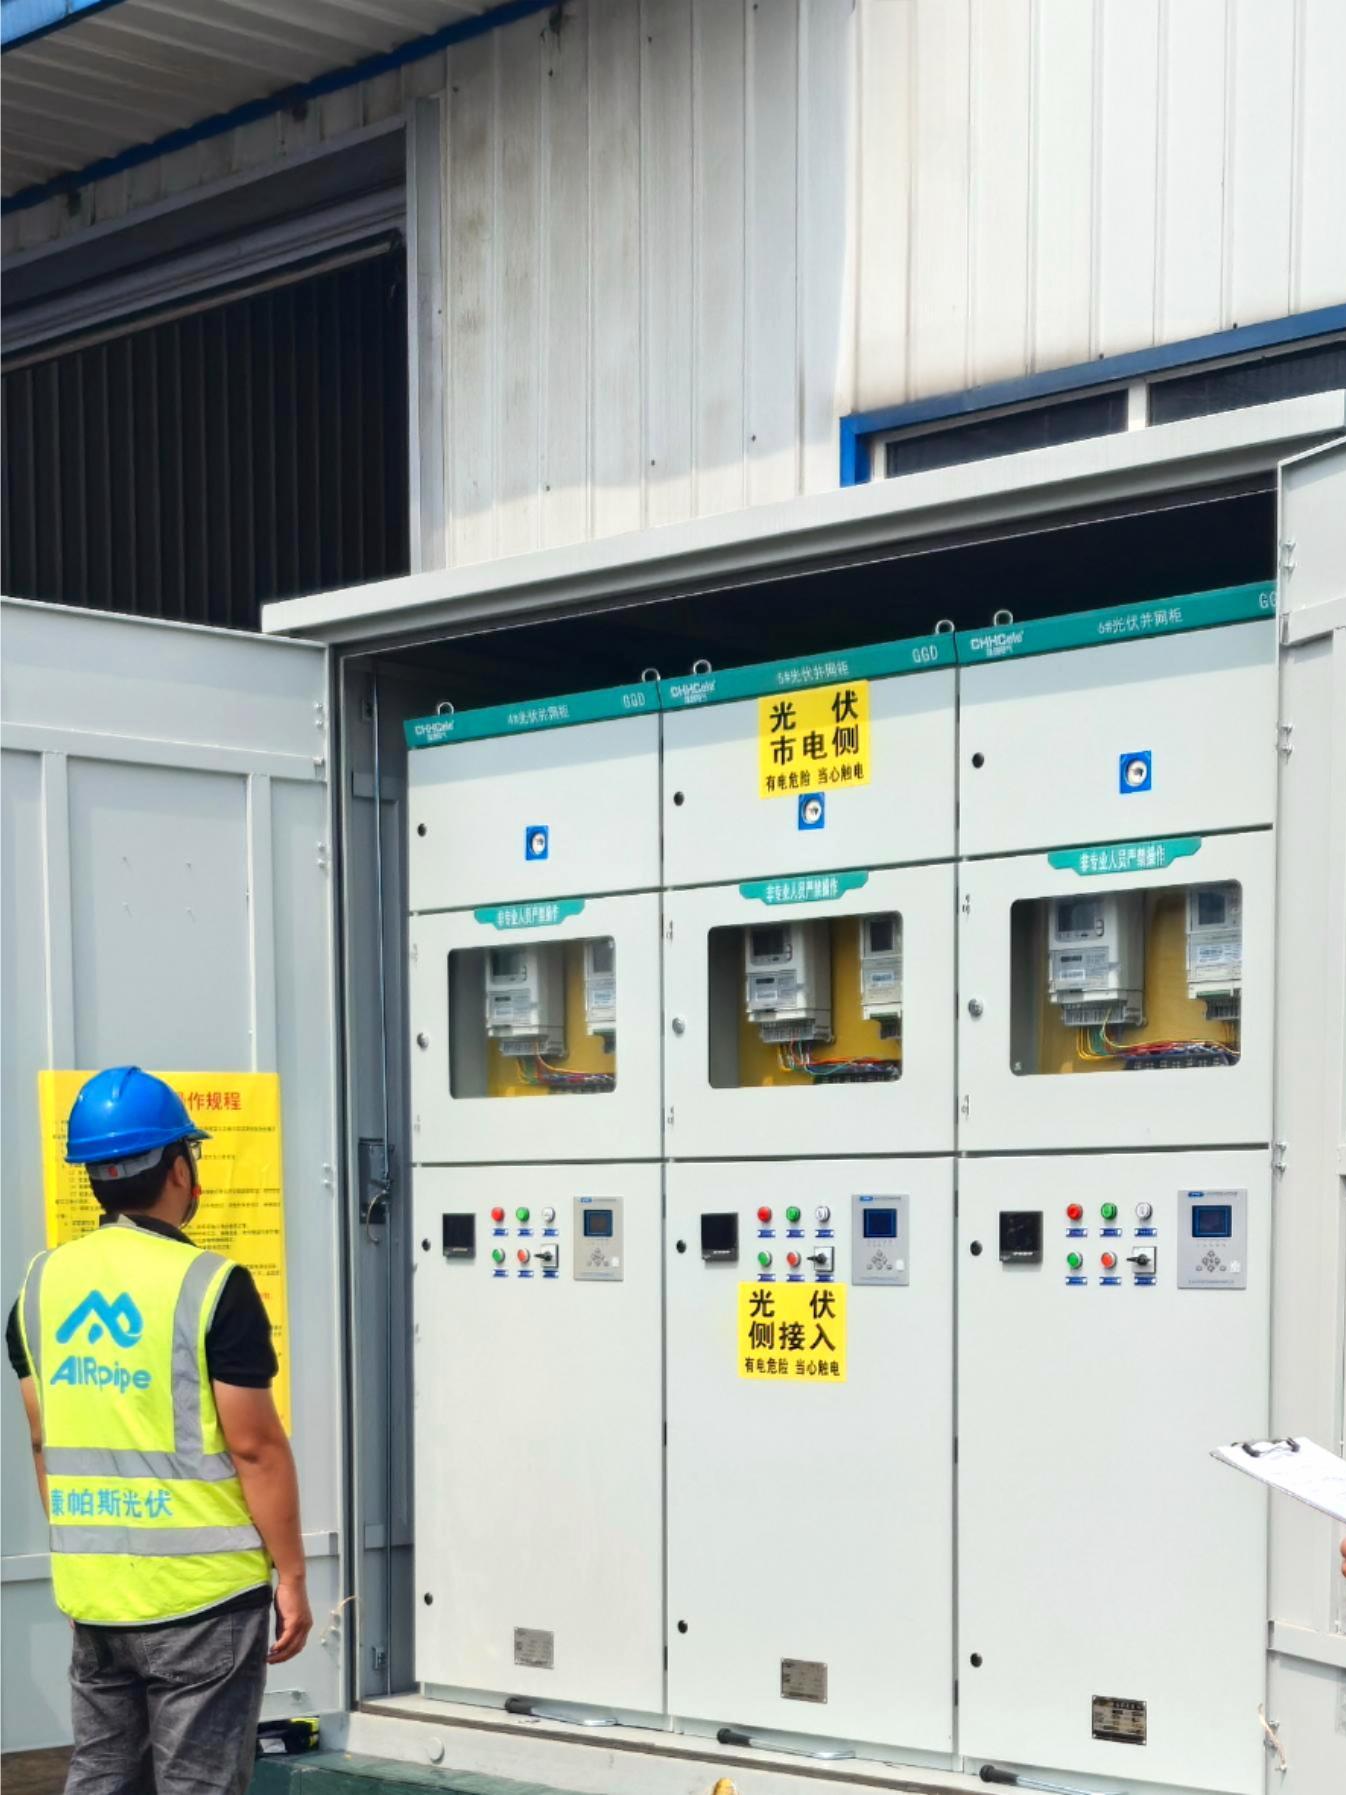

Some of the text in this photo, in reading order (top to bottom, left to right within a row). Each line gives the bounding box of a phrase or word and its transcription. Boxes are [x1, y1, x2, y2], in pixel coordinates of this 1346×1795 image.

[1259, 591, 1277, 608] GG
[912, 645, 938, 663] GGD
[769, 689, 858, 733] 光 伏
[770, 724, 860, 766] 市电侧
[766, 762, 864, 792] 有电危险 当心触电
[179, 1090, 242, 1112] 作规程
[749, 1288, 836, 1319] 光 伏
[748, 1320, 836, 1351] 侧接入
[50, 1355, 152, 1394] AIRpipe
[745, 1357, 840, 1376] 有电危险 当心触电
